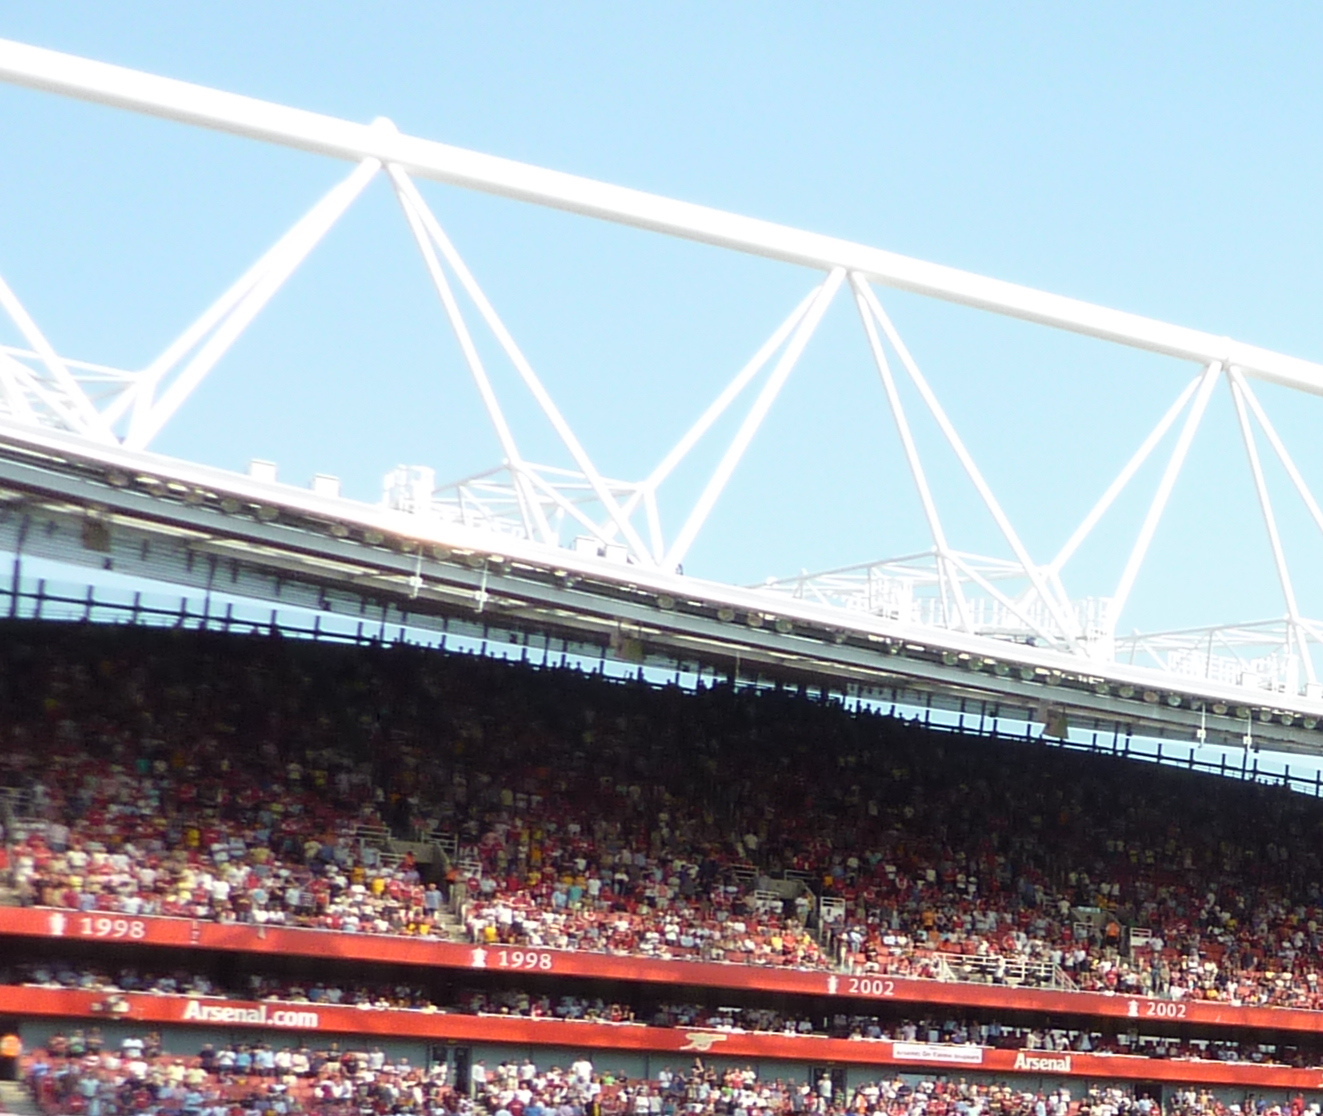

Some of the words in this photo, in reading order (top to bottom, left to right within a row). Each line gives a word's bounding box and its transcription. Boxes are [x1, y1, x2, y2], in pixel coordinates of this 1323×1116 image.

[80, 917, 146, 939] 1998
[498, 950, 552, 970] 1998
[849, 978, 895, 996] 2002
[184, 1000, 318, 1028] Arsenal.com
[1147, 1002, 1187, 1019] 2002
[1014, 1053, 1071, 1072] Arsenal
